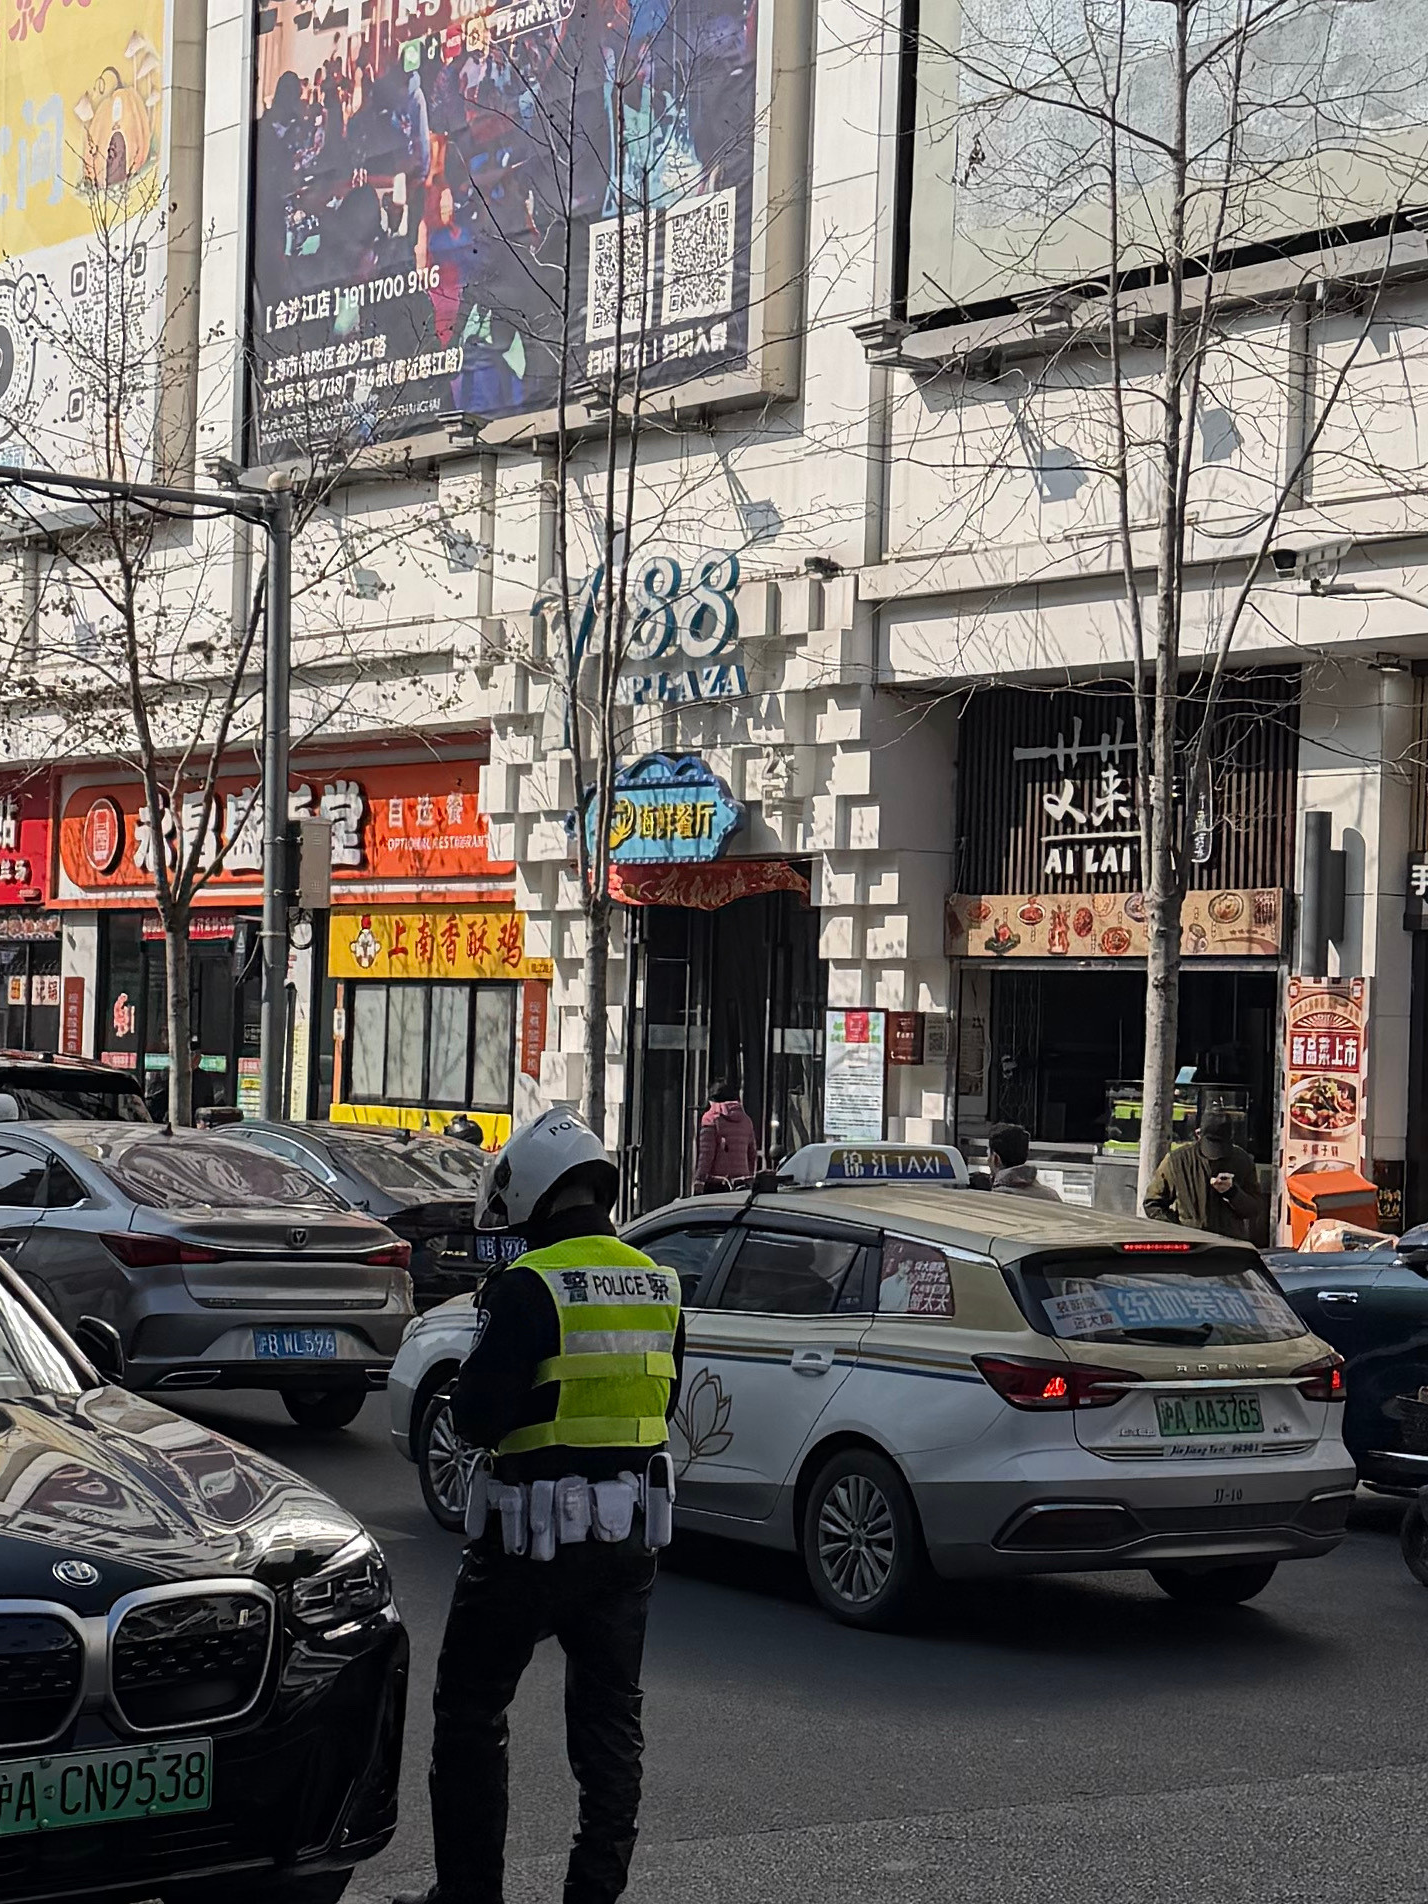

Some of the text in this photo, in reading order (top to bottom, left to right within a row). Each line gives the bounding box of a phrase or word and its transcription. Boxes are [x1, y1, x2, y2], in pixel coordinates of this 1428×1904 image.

[368, 274, 405, 303] 1700
[388, 792, 480, 829] 自选餐
[388, 913, 524, 969] 上南香酥鸡
[841, 1151, 941, 1178] 锦江 TAXI
[559, 1270, 589, 1303] 警
[593, 1274, 647, 1296] POLICE
[1195, 1397, 1262, 1429] AA3765
[60, 1751, 206, 1816] CN9538
